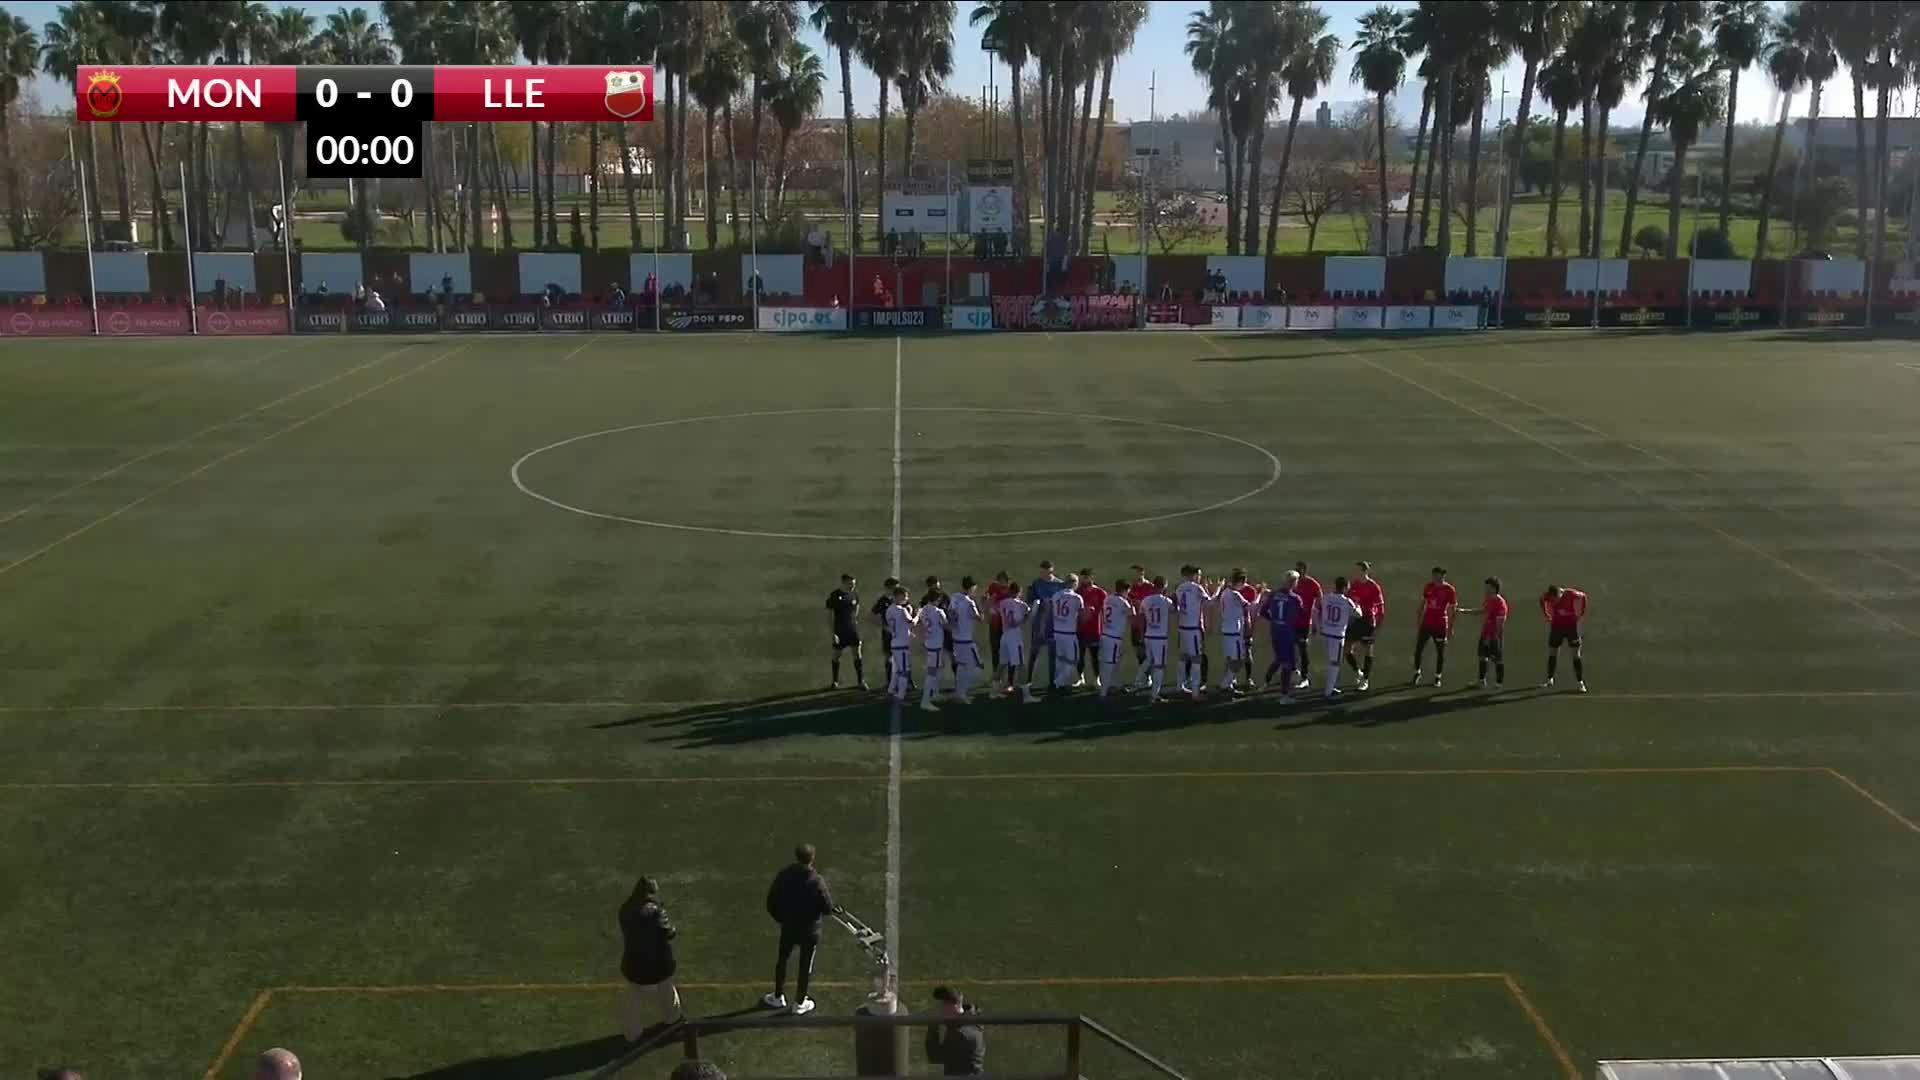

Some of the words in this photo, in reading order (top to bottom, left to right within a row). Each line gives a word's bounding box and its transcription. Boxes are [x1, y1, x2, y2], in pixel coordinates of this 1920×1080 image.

[309, 313, 340, 325] ATRIO
[358, 313, 389, 325] ATRIO
[406, 313, 437, 325] ATRIO
[455, 313, 486, 325] ATRIO
[503, 313, 535, 325] ATRIO
[552, 313, 584, 325] ATRIO
[601, 312, 632, 324] ATRIO
[693, 314, 714, 323] DON
[773, 309, 833, 327] cjpa.es
[967, 311, 991, 328] cjp
[1056, 599, 1070, 617] 16
[1278, 600, 1284, 618] 1
[1326, 604, 1341, 622] 10
